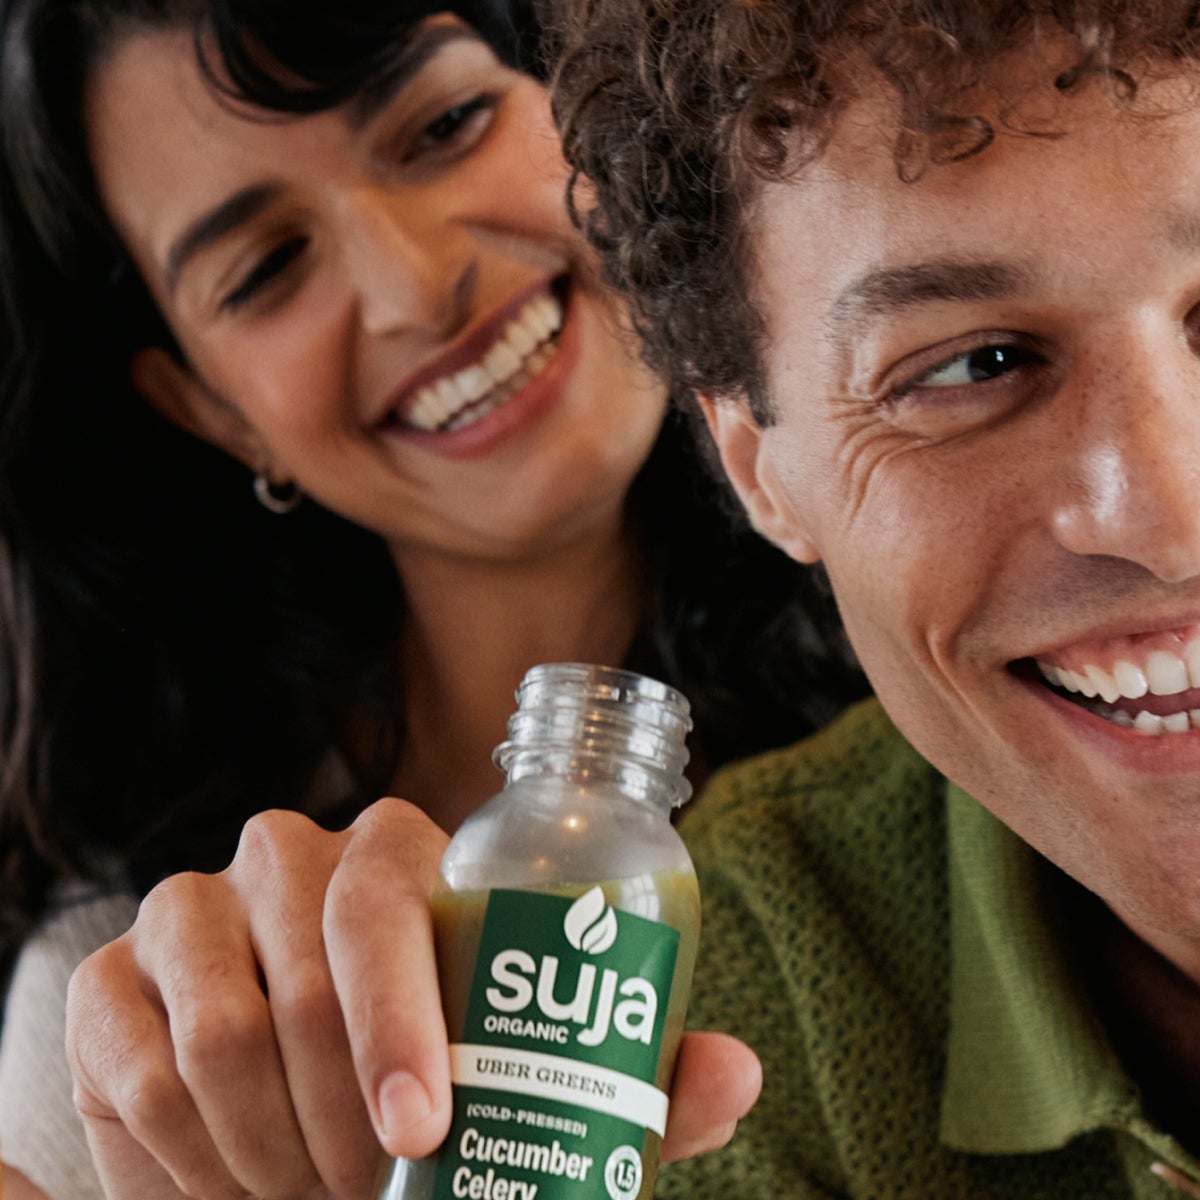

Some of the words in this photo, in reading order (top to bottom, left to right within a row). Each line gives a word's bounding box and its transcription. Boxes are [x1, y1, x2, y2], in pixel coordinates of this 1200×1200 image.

[486, 949, 658, 1047] suja
[484, 1015, 569, 1044] ORGANIC
[476, 1057, 531, 1080] UBER
[536, 1066, 617, 1100] GREENS
[460, 1127, 593, 1181] Cucumber
